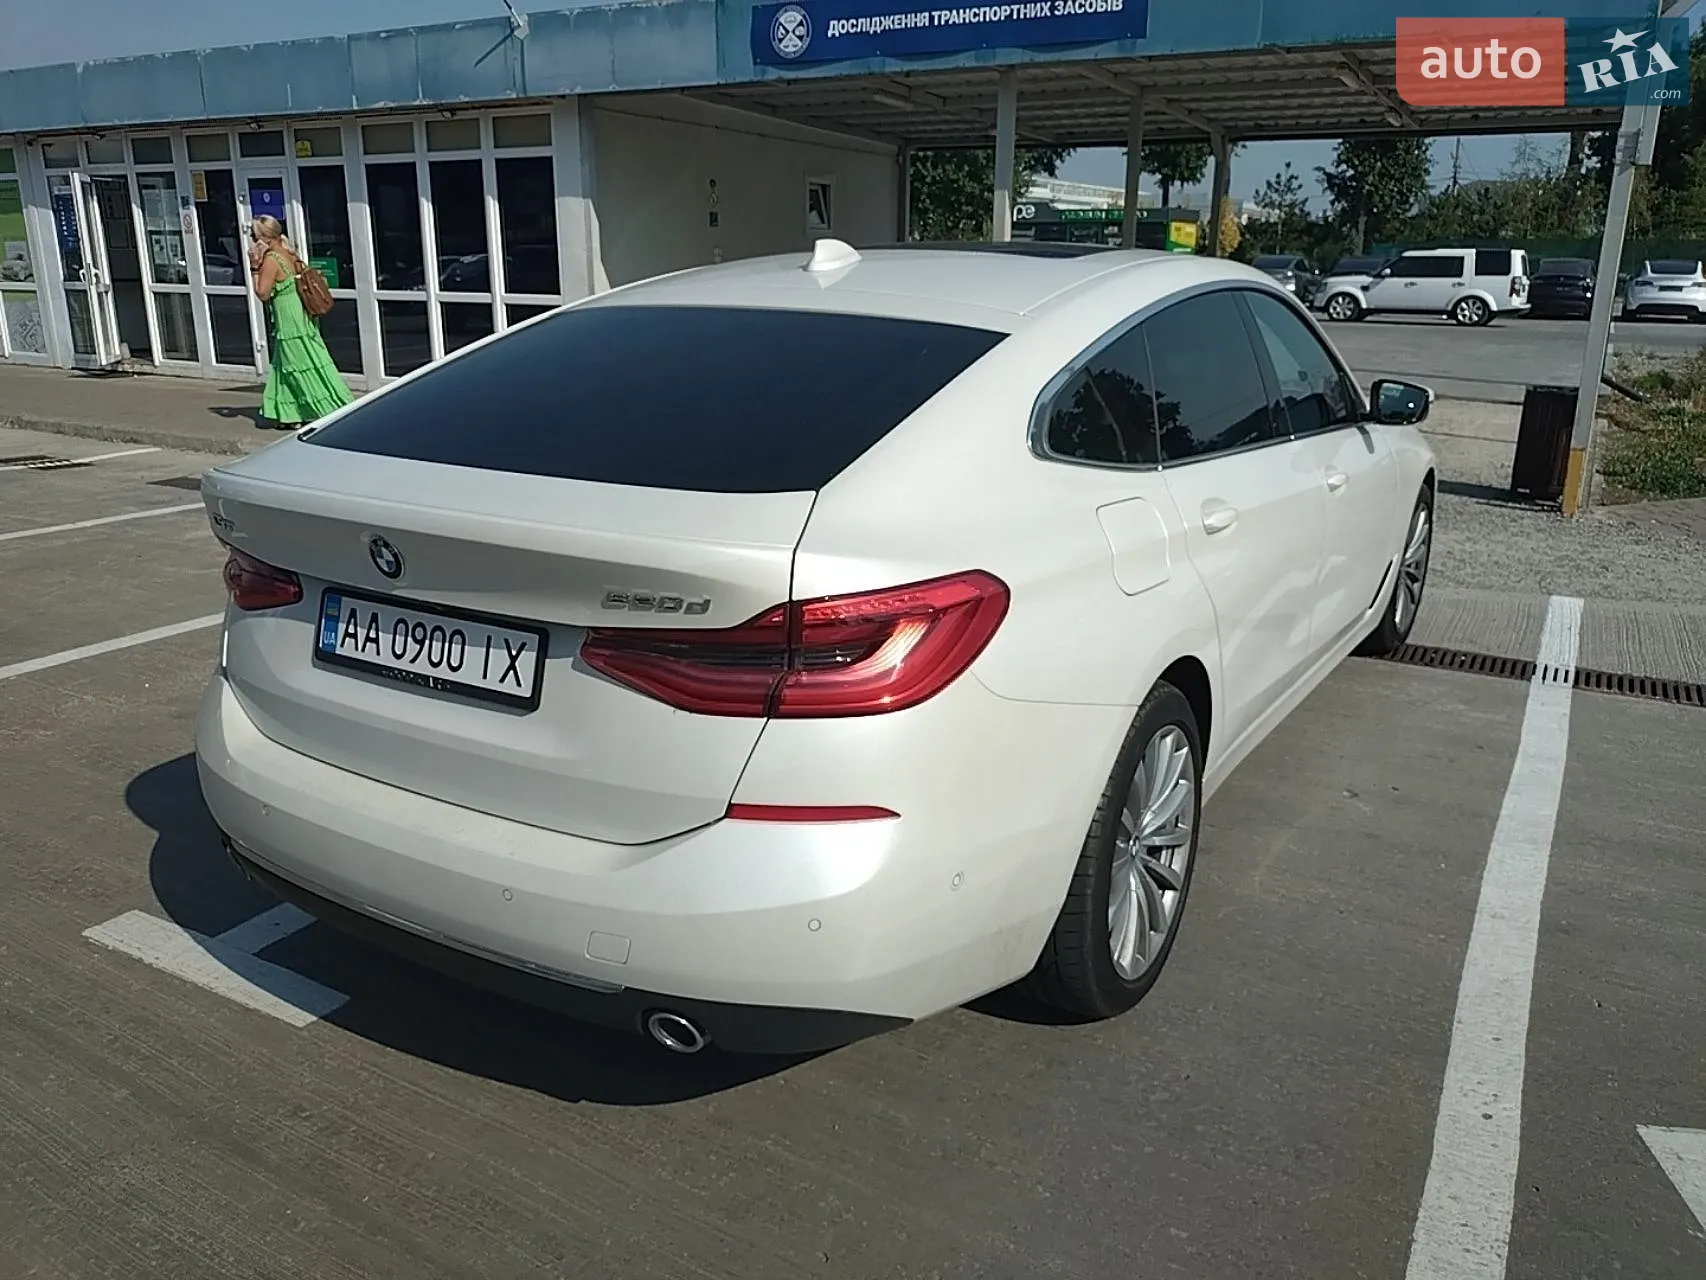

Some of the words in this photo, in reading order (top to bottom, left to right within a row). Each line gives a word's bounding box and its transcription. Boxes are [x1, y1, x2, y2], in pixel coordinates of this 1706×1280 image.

[828, 15, 930, 38] ДОСЛІДЖЕННЯ
[932, 2, 1051, 26] ТРАНСПОРТНИХ
[1054, 0, 1124, 14] ЗАСОБІВ
[323, 631, 336, 645] UA
[340, 607, 381, 656] AA
[391, 617, 467, 673] 0900
[482, 634, 528, 688] IX
